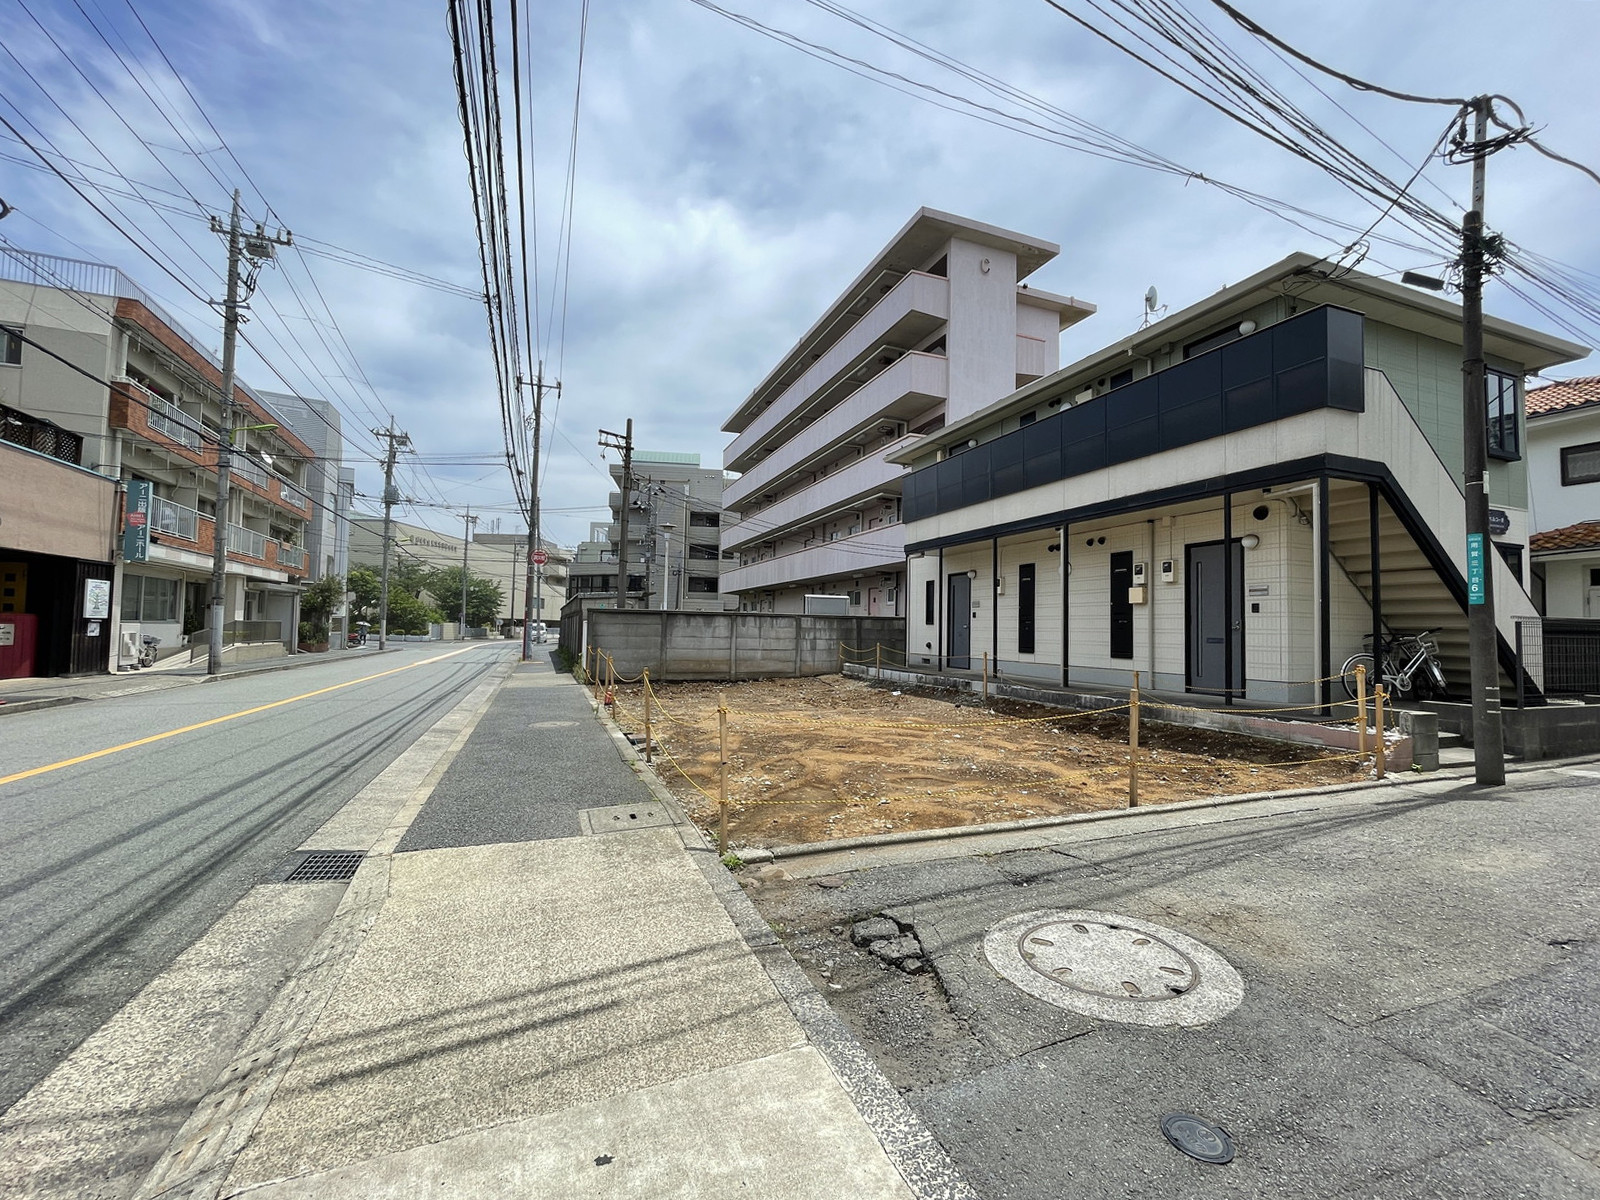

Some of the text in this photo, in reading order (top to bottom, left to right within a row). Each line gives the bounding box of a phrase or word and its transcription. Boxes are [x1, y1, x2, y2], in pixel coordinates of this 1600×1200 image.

[135, 524, 145, 558] アーニホール
